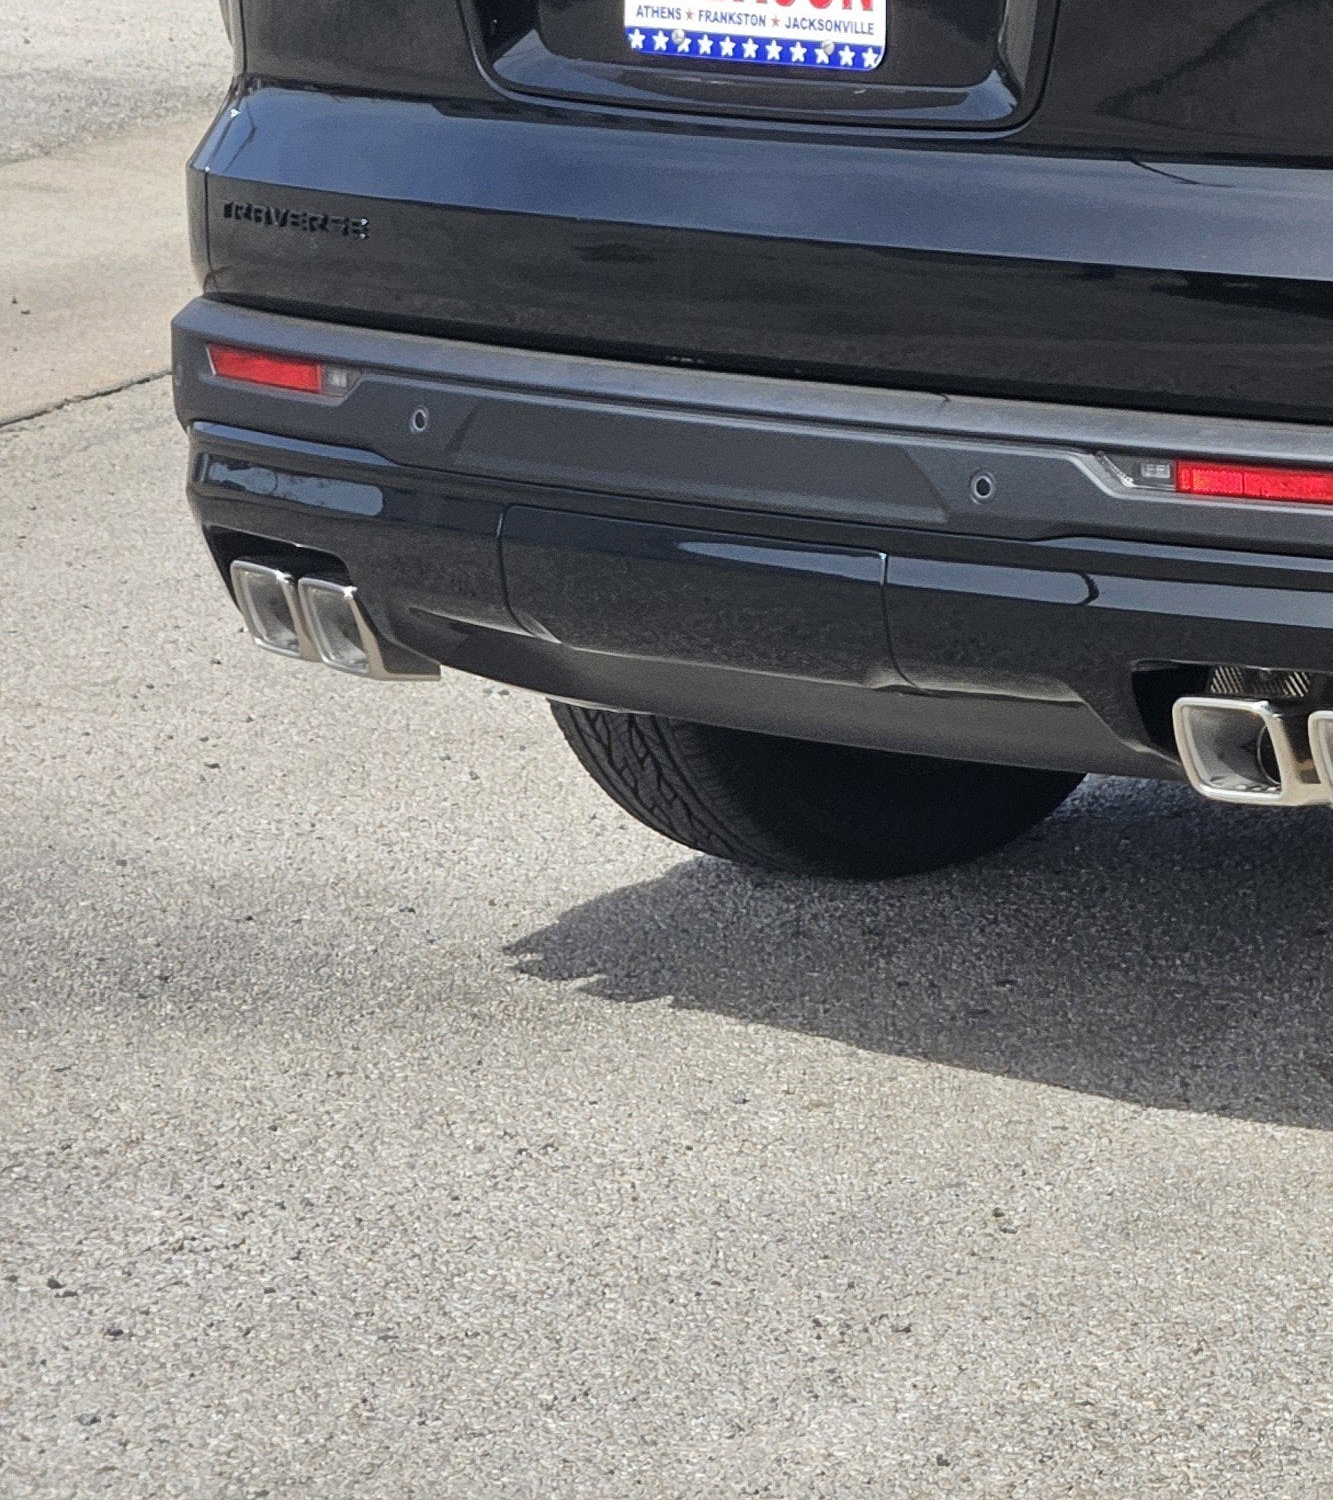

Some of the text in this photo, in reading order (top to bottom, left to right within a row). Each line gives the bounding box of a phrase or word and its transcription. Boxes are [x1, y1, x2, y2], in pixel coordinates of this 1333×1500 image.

[636, 4, 874, 36] ATHENS FRANKSTON JACKSONVILLE
